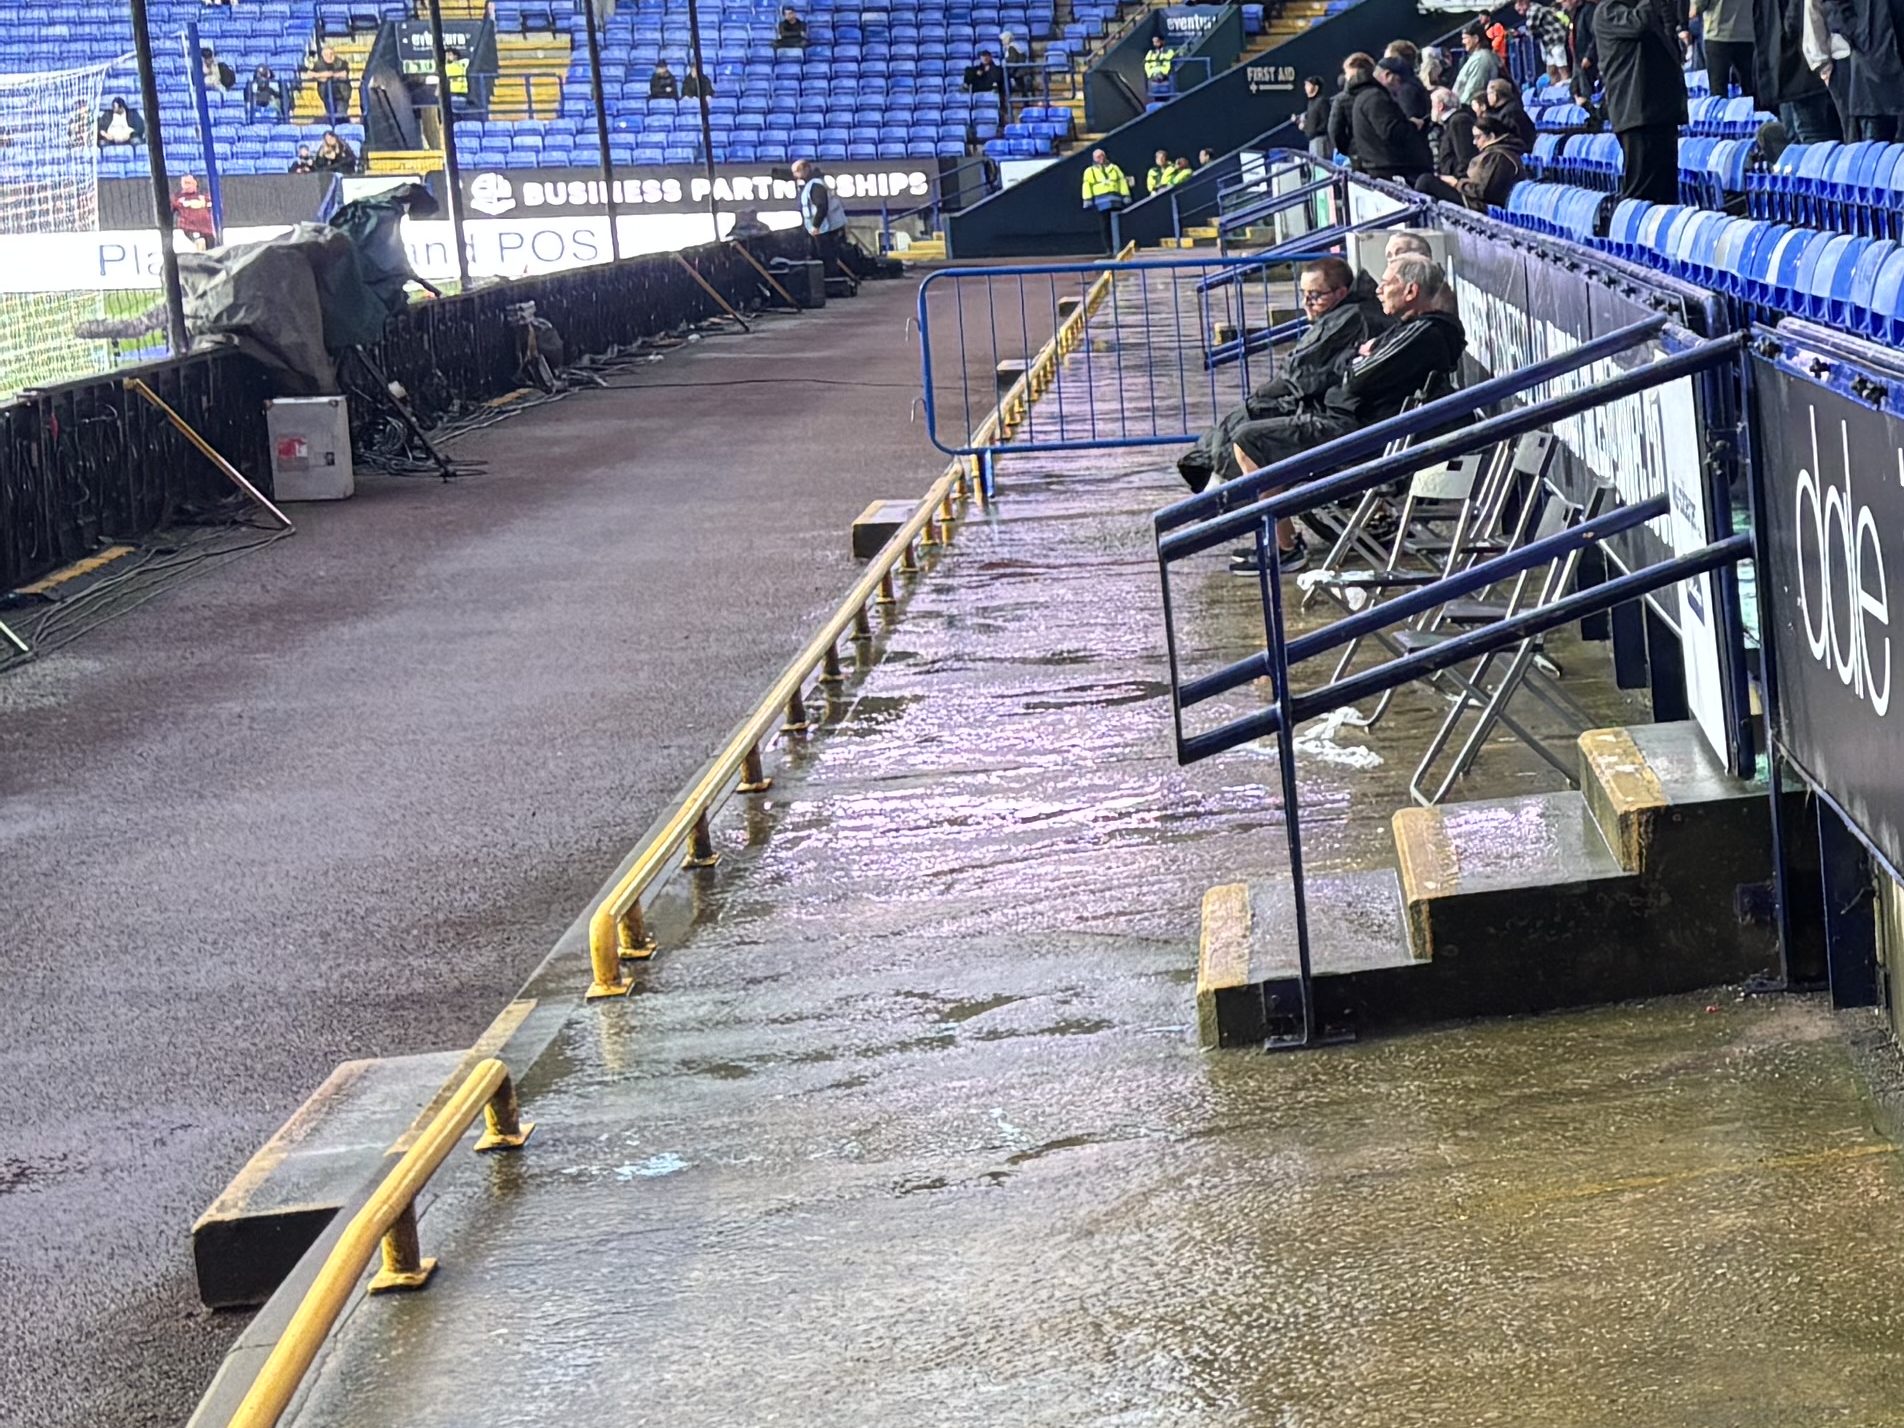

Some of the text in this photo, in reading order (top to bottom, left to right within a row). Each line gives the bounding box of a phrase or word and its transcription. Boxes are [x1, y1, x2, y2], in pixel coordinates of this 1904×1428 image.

[1246, 66, 1296, 83] FIRST AID
[689, 171, 930, 203] PARTNSHIPS
[498, 227, 600, 263] POS
[1795, 404, 1892, 718] dale
